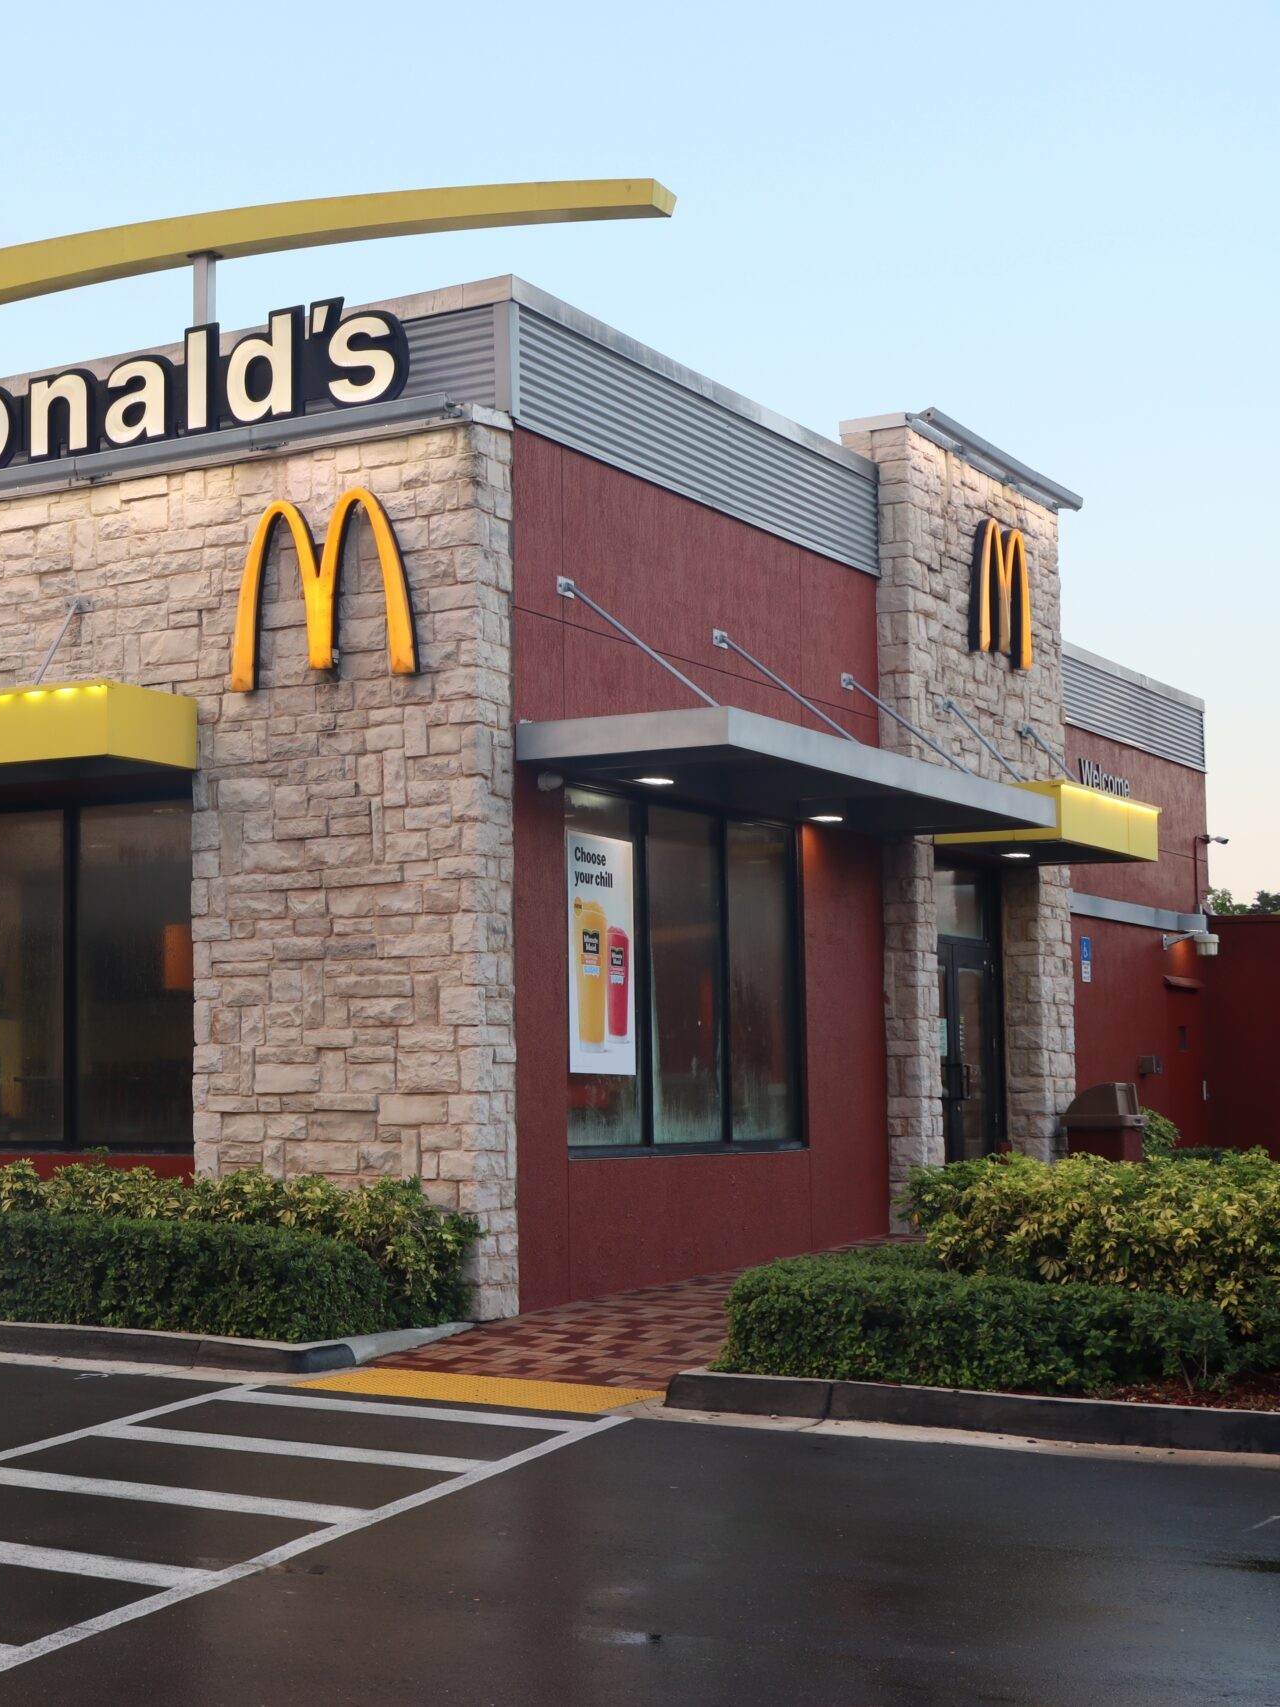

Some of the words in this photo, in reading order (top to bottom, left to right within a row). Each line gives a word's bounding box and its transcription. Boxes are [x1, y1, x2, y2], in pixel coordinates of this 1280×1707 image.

[1079, 758, 1130, 797] Welcome
[574, 846, 607, 866] Choose
[574, 870, 594, 887] your
[595, 871, 613, 888] chill
